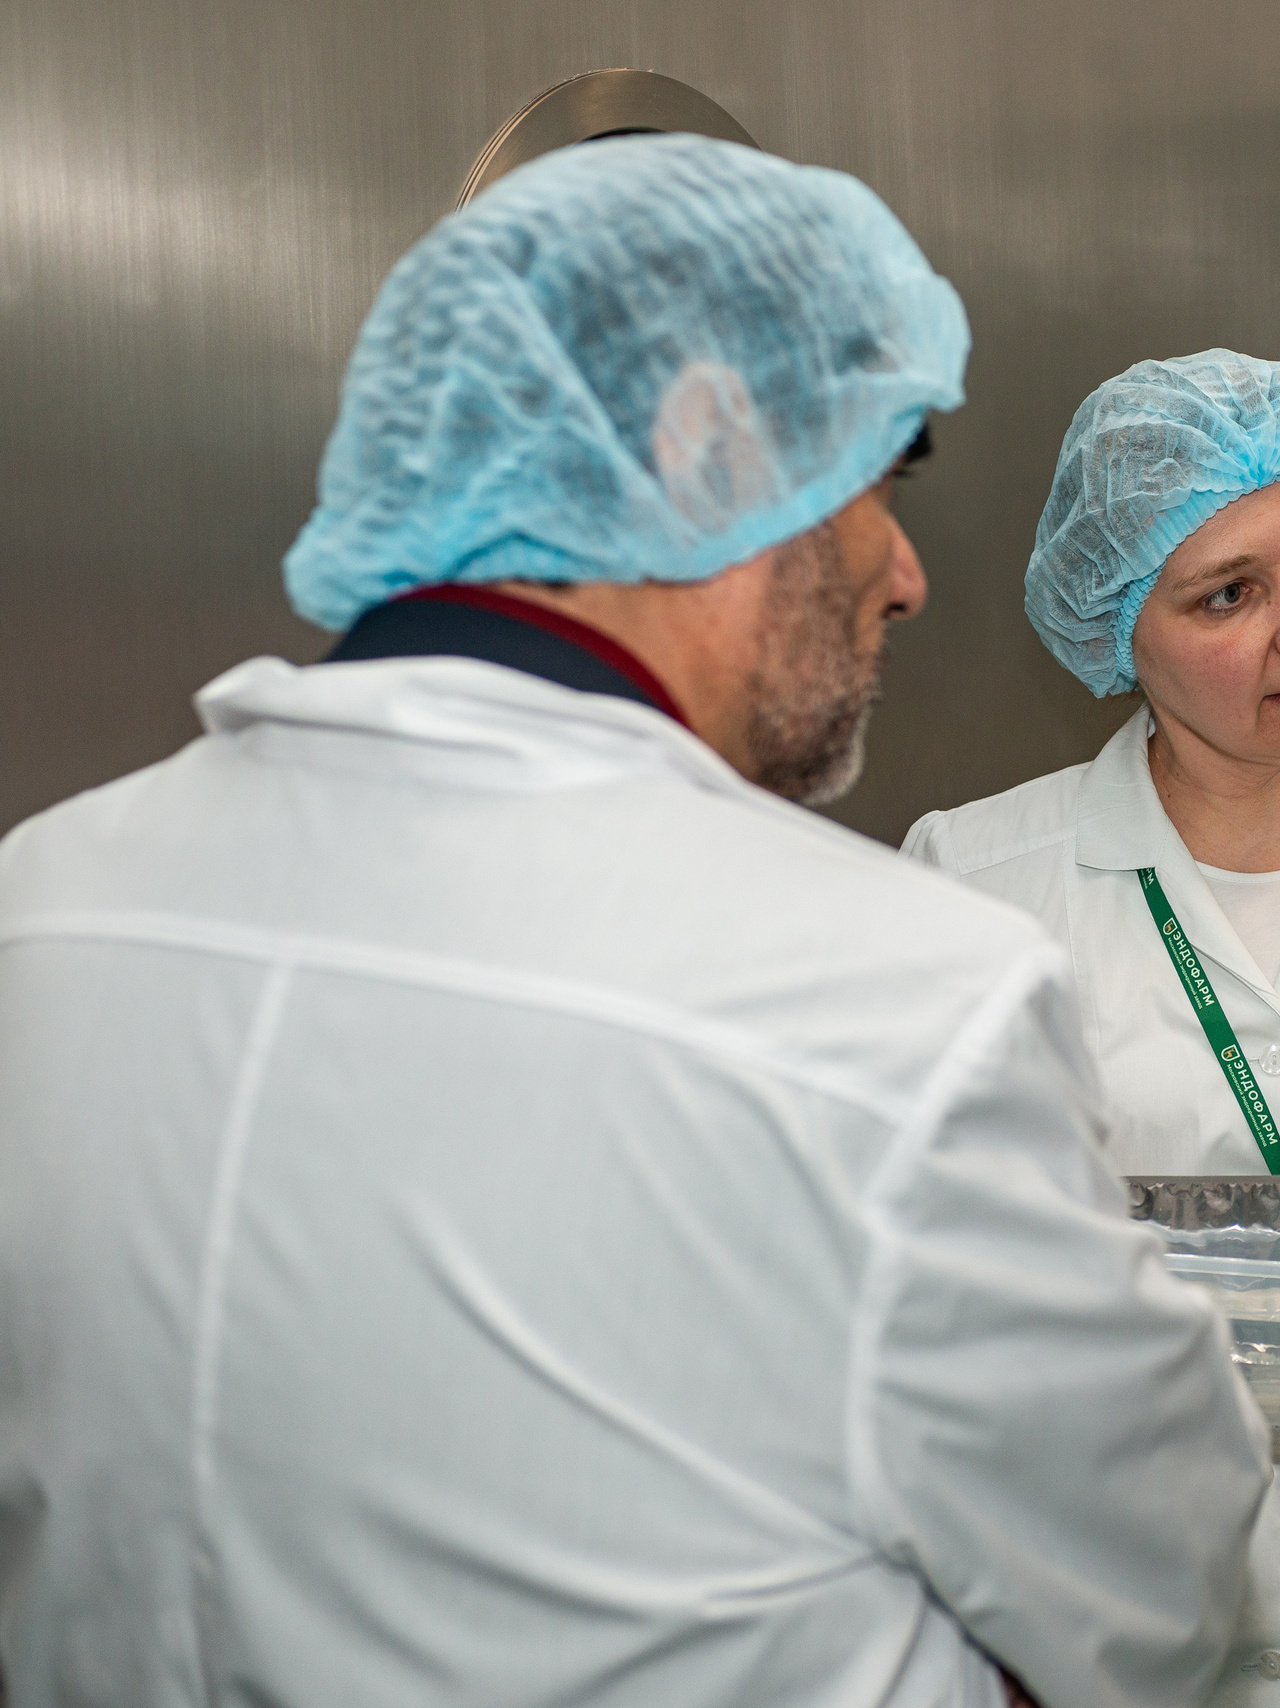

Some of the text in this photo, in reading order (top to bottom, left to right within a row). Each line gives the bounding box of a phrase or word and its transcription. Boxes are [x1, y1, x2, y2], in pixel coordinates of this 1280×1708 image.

[1173, 931, 1215, 1006] ЭНДОФАРМ
[1226, 1063, 1267, 1147] Московский эндокринный завод
[1234, 1059, 1278, 1145] ЭНДОФАРМ
